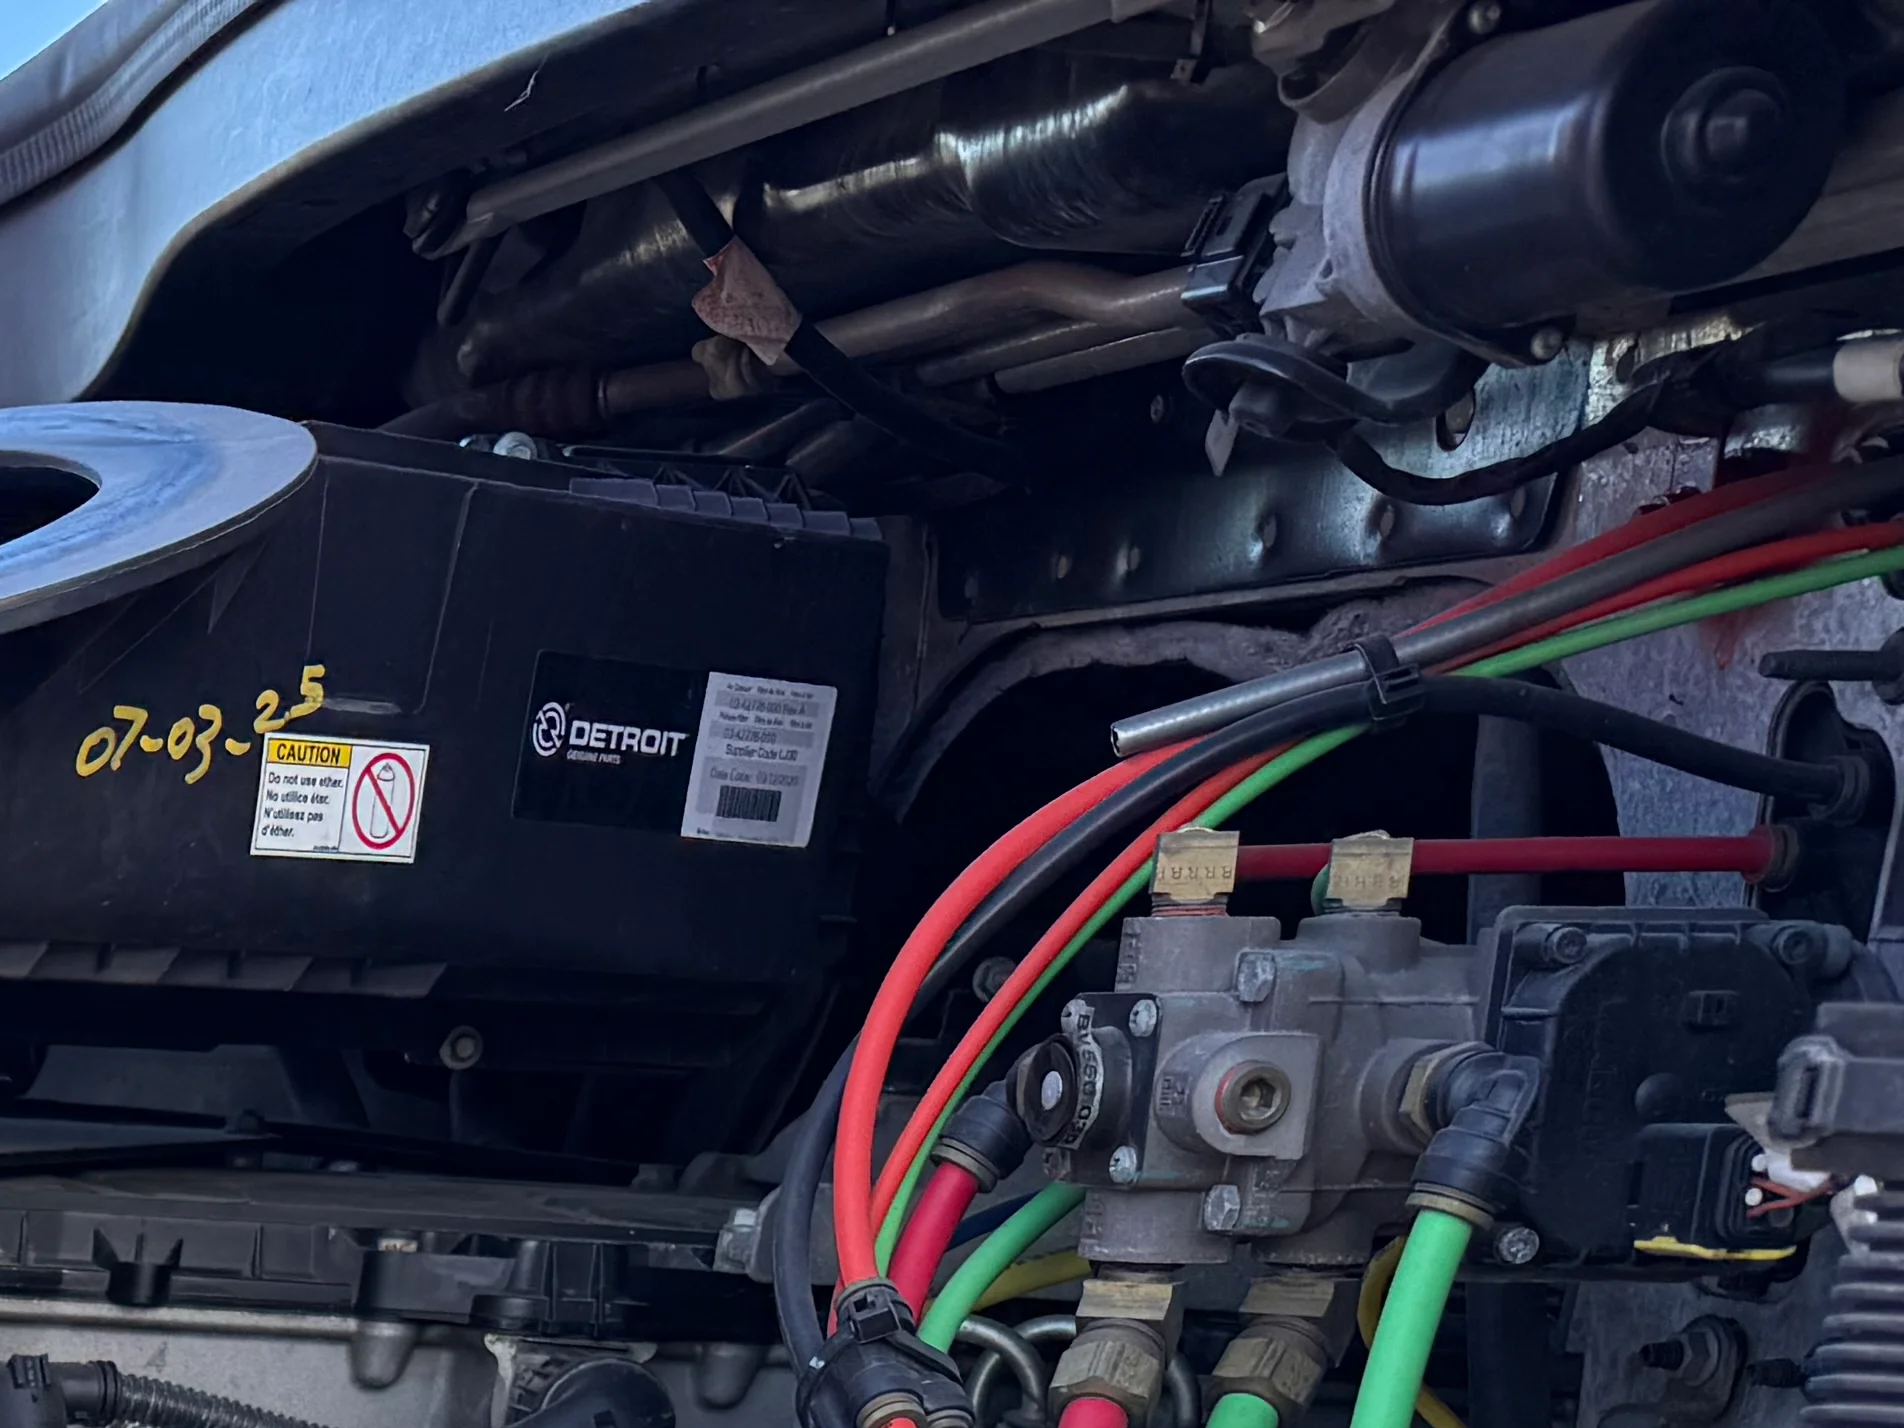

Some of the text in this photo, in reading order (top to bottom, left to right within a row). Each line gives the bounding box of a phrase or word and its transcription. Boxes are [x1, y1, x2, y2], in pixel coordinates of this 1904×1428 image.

[75, 663, 326, 786] 07-03-25
[569, 719, 690, 757] DETROIT
[276, 742, 341, 765] CAUTION
[268, 771, 281, 784] Do
[282, 773, 299, 787] not
[300, 778, 317, 789] use
[266, 790, 280, 803] No
[306, 811, 324, 825] pas
